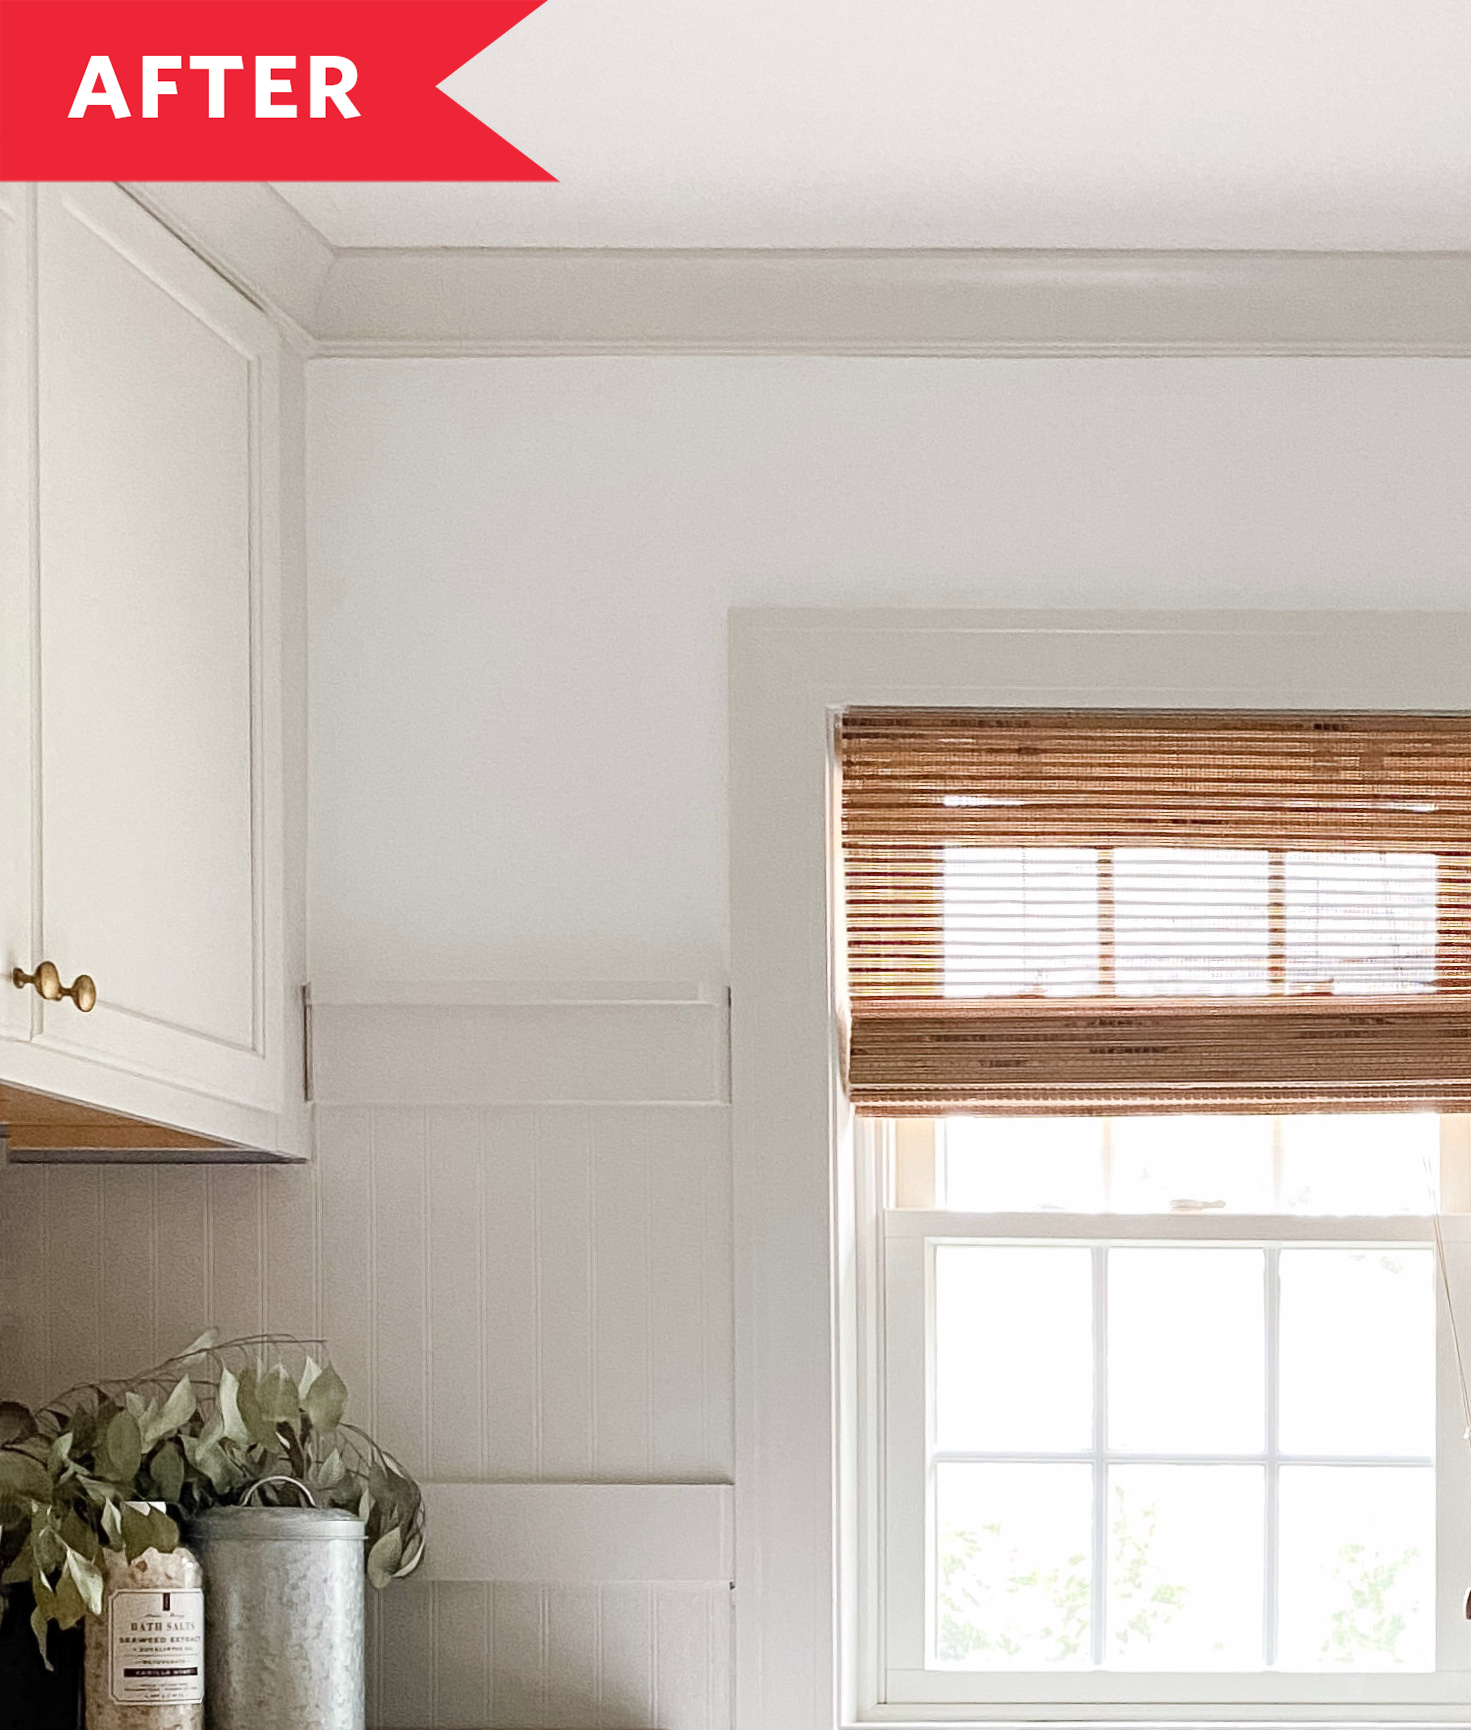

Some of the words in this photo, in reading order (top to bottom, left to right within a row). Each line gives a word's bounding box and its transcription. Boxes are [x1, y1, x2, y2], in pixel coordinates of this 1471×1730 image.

[131, 1622, 162, 1631] BATH
[166, 1622, 195, 1631] SALTS
[170, 1635, 201, 1643] EXTRACT
